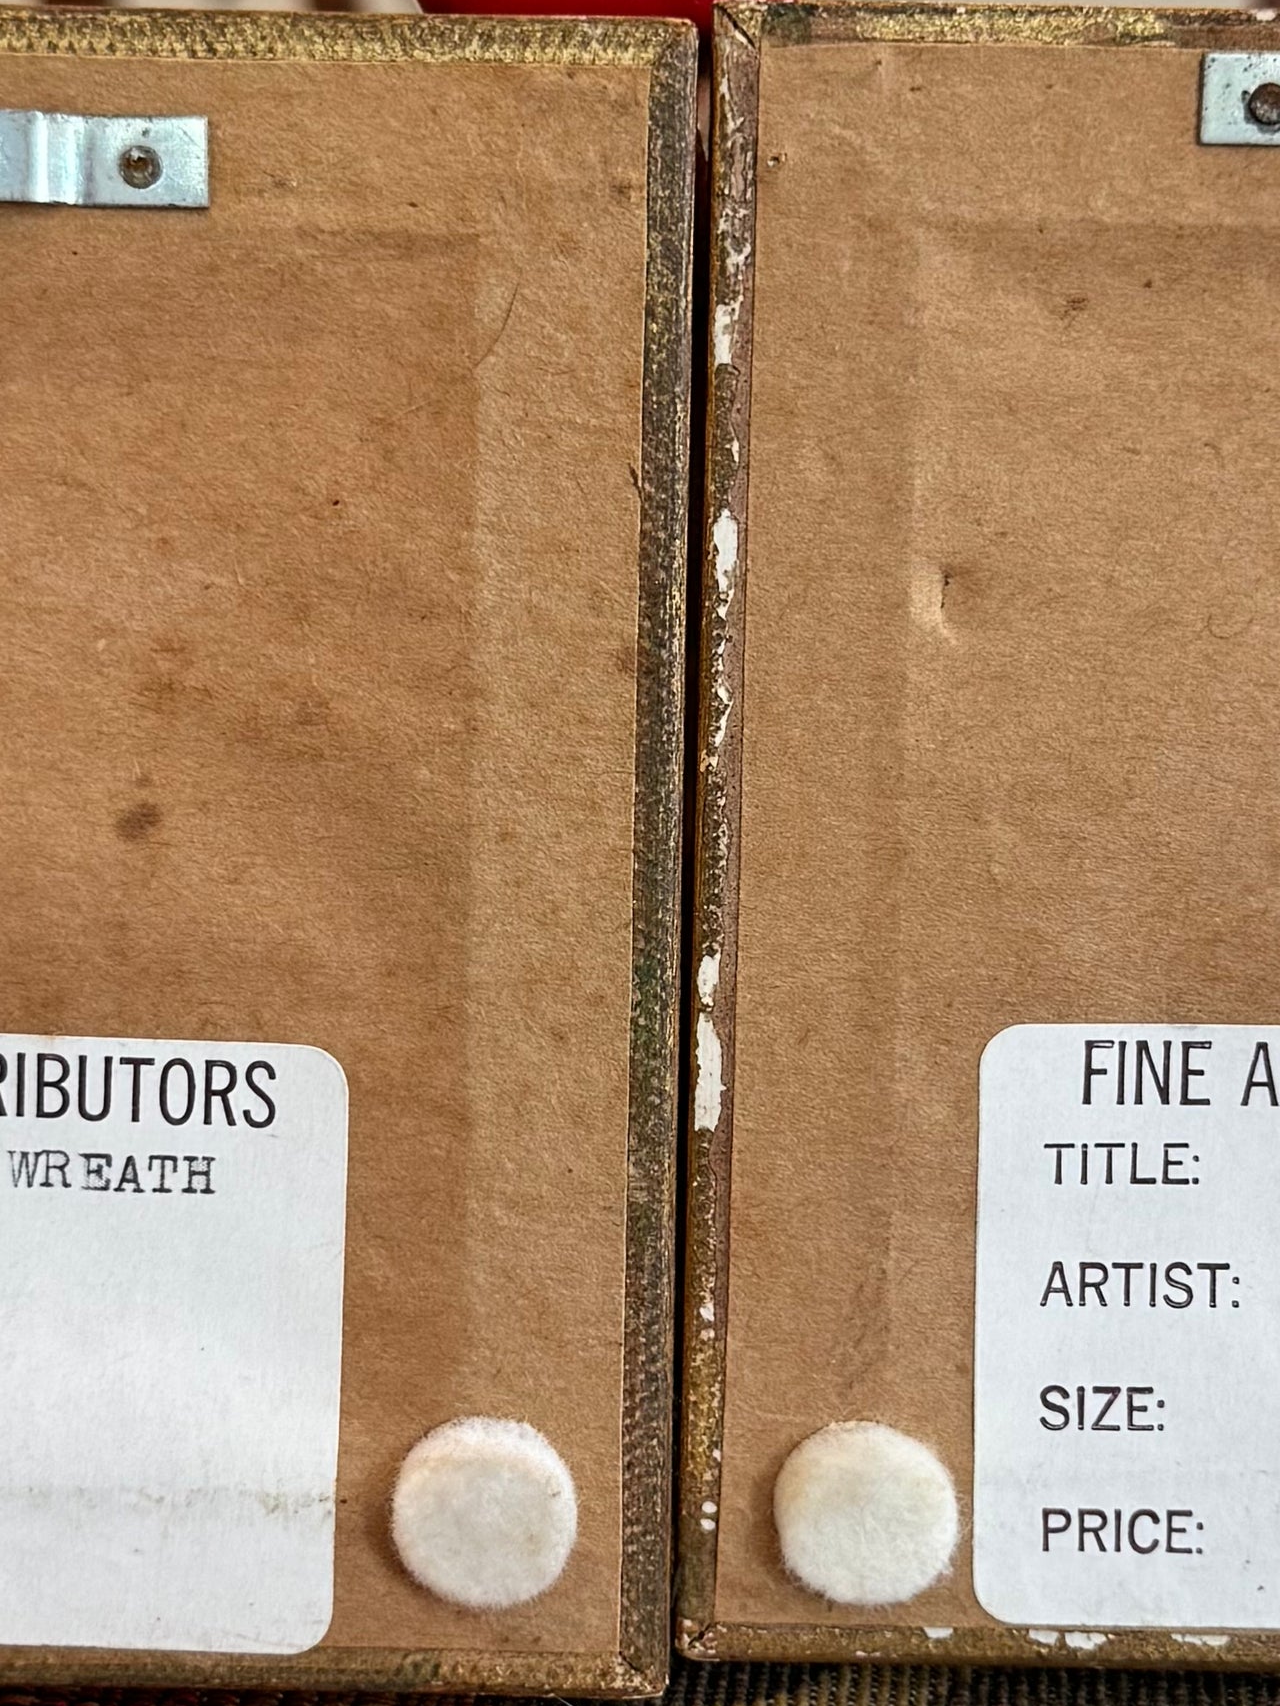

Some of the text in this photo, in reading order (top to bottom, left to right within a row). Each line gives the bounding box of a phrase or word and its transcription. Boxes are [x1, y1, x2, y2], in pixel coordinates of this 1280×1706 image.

[1082, 1040, 1212, 1106] FINE
[7, 1150, 216, 1194] WREATH
[1044, 1142, 1199, 1185] TITLE:
[1040, 1261, 1240, 1309] ARTIST:
[1040, 1385, 1165, 1431] SIZE:
[1042, 1508, 1204, 1555] PRICE:
